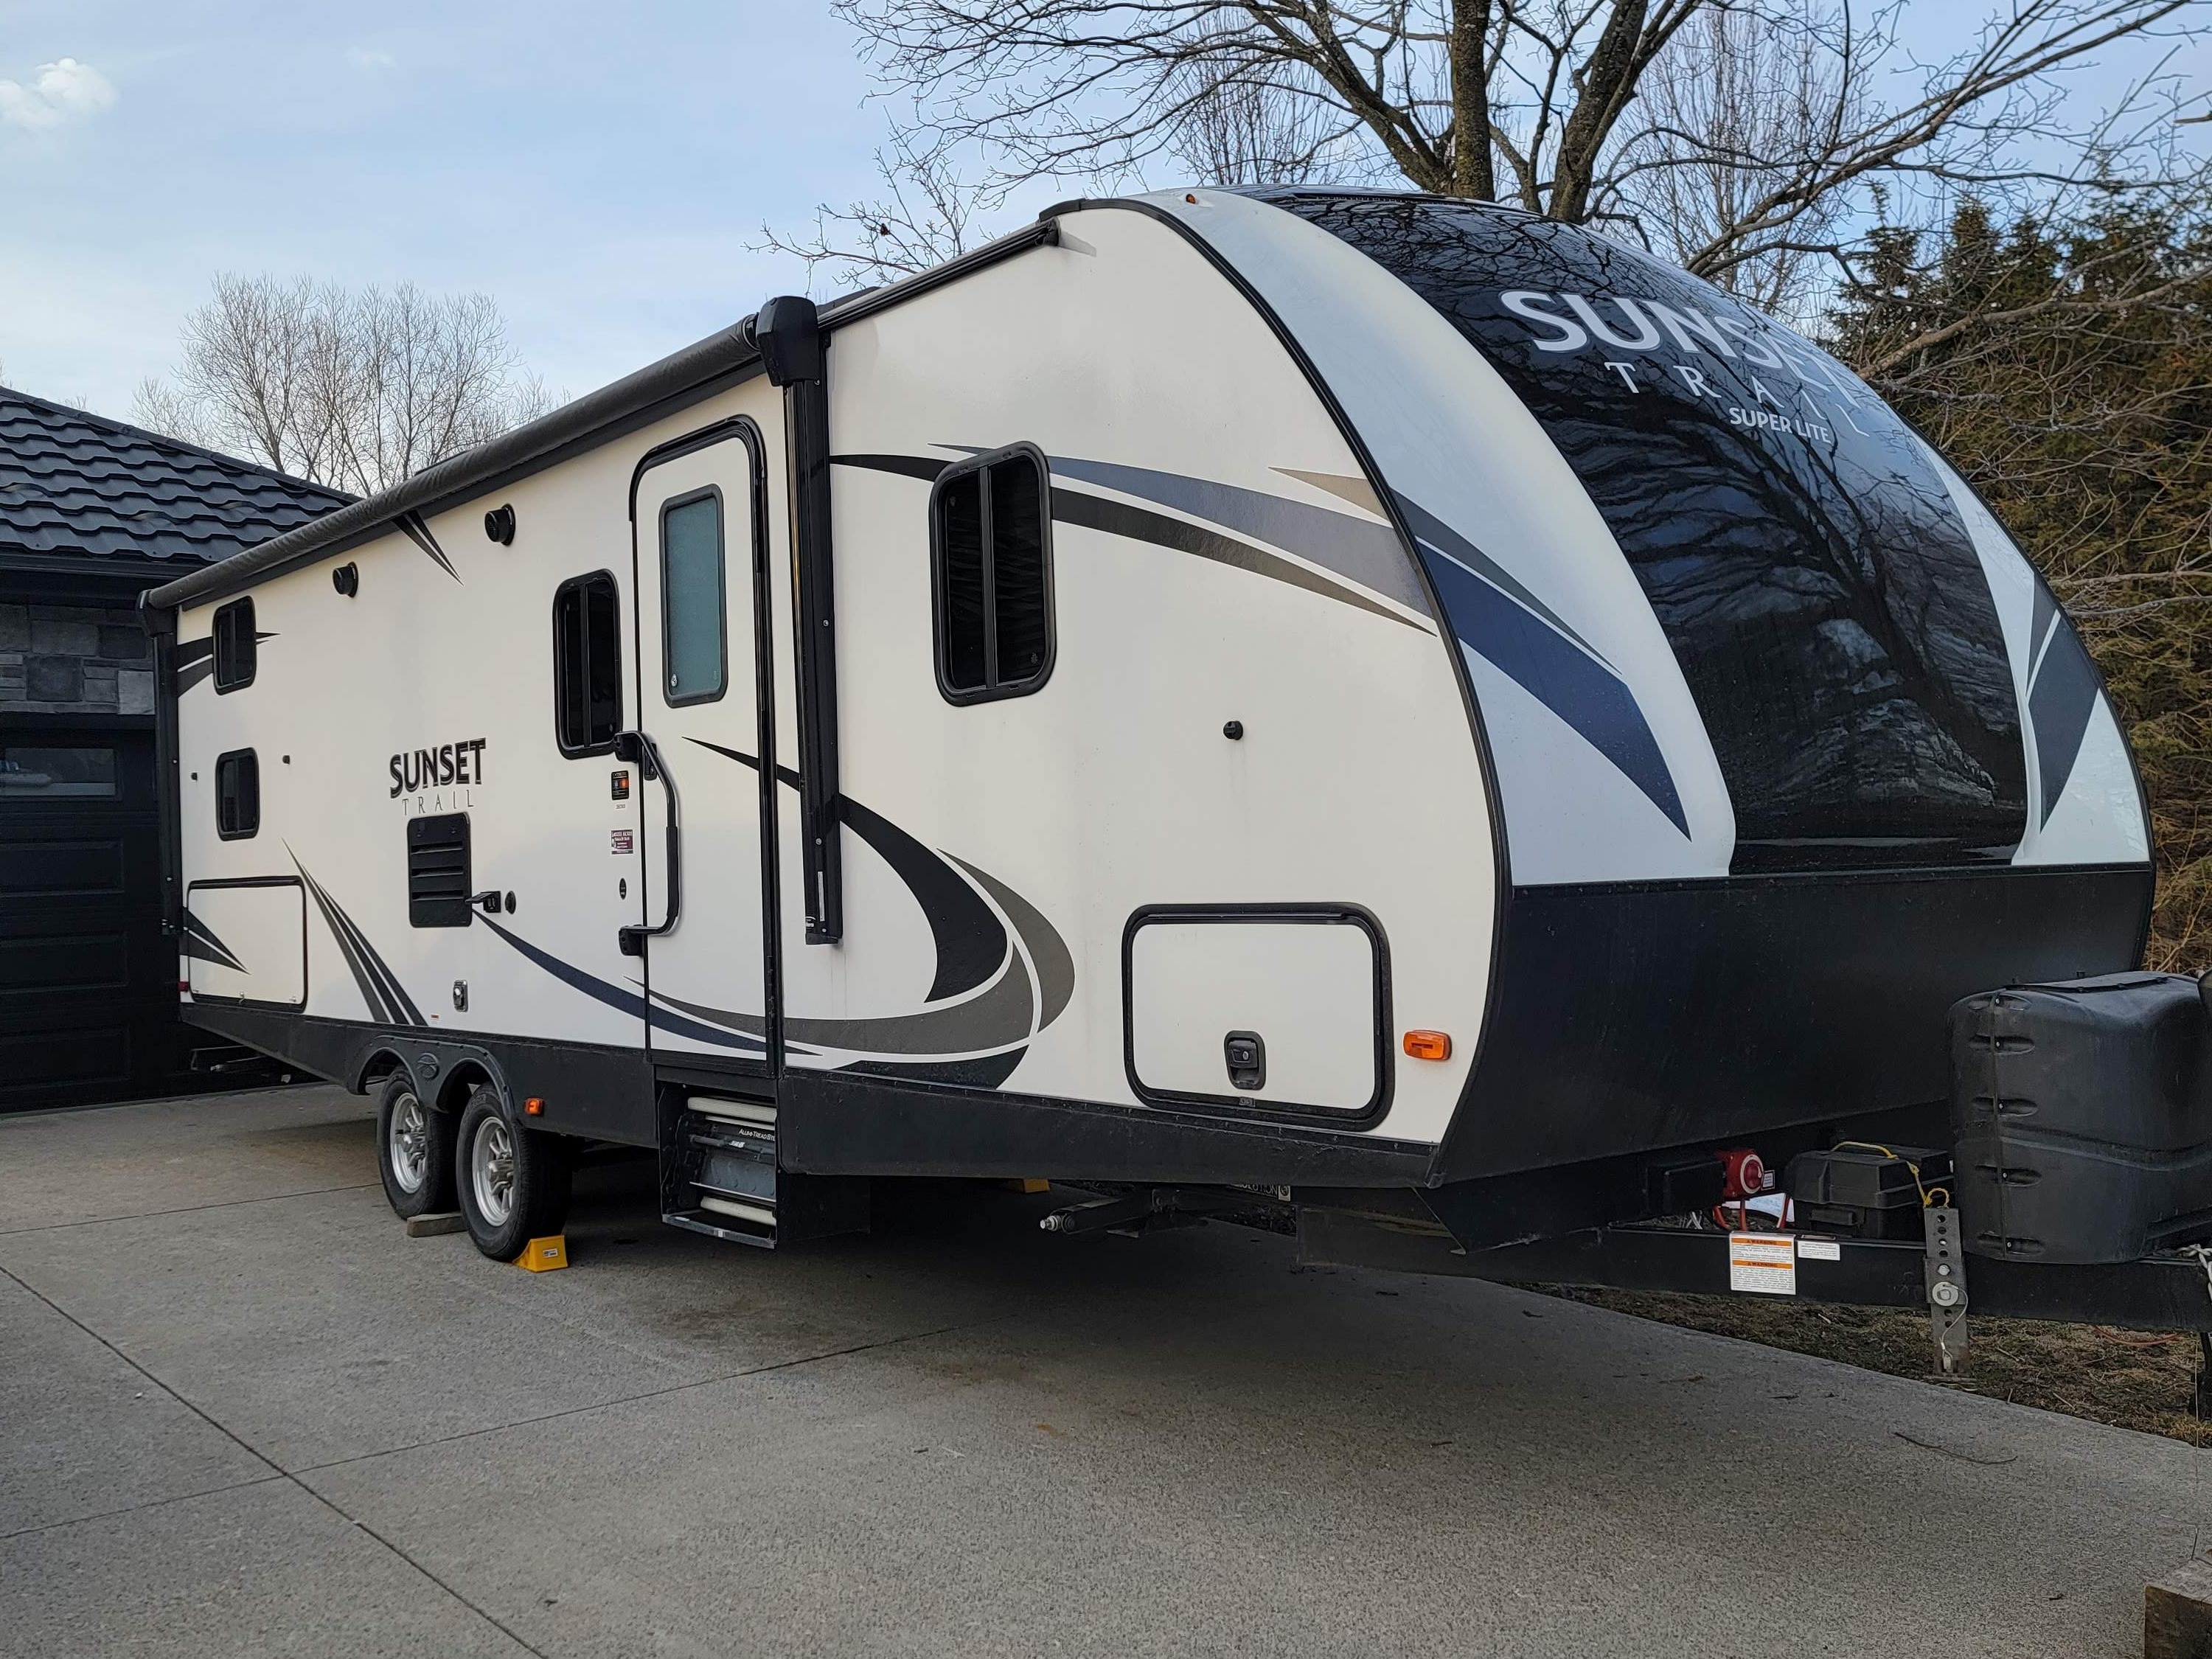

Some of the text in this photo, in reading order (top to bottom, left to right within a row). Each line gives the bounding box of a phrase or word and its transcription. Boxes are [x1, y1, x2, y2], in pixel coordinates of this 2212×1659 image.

[1500, 291, 1862, 409] SUNSET
[1604, 361, 1871, 437] TRAIL
[1728, 407, 1832, 444] SUPER LITE
[389, 737, 487, 799] SUNSET
[402, 789, 475, 815] TRAIL
